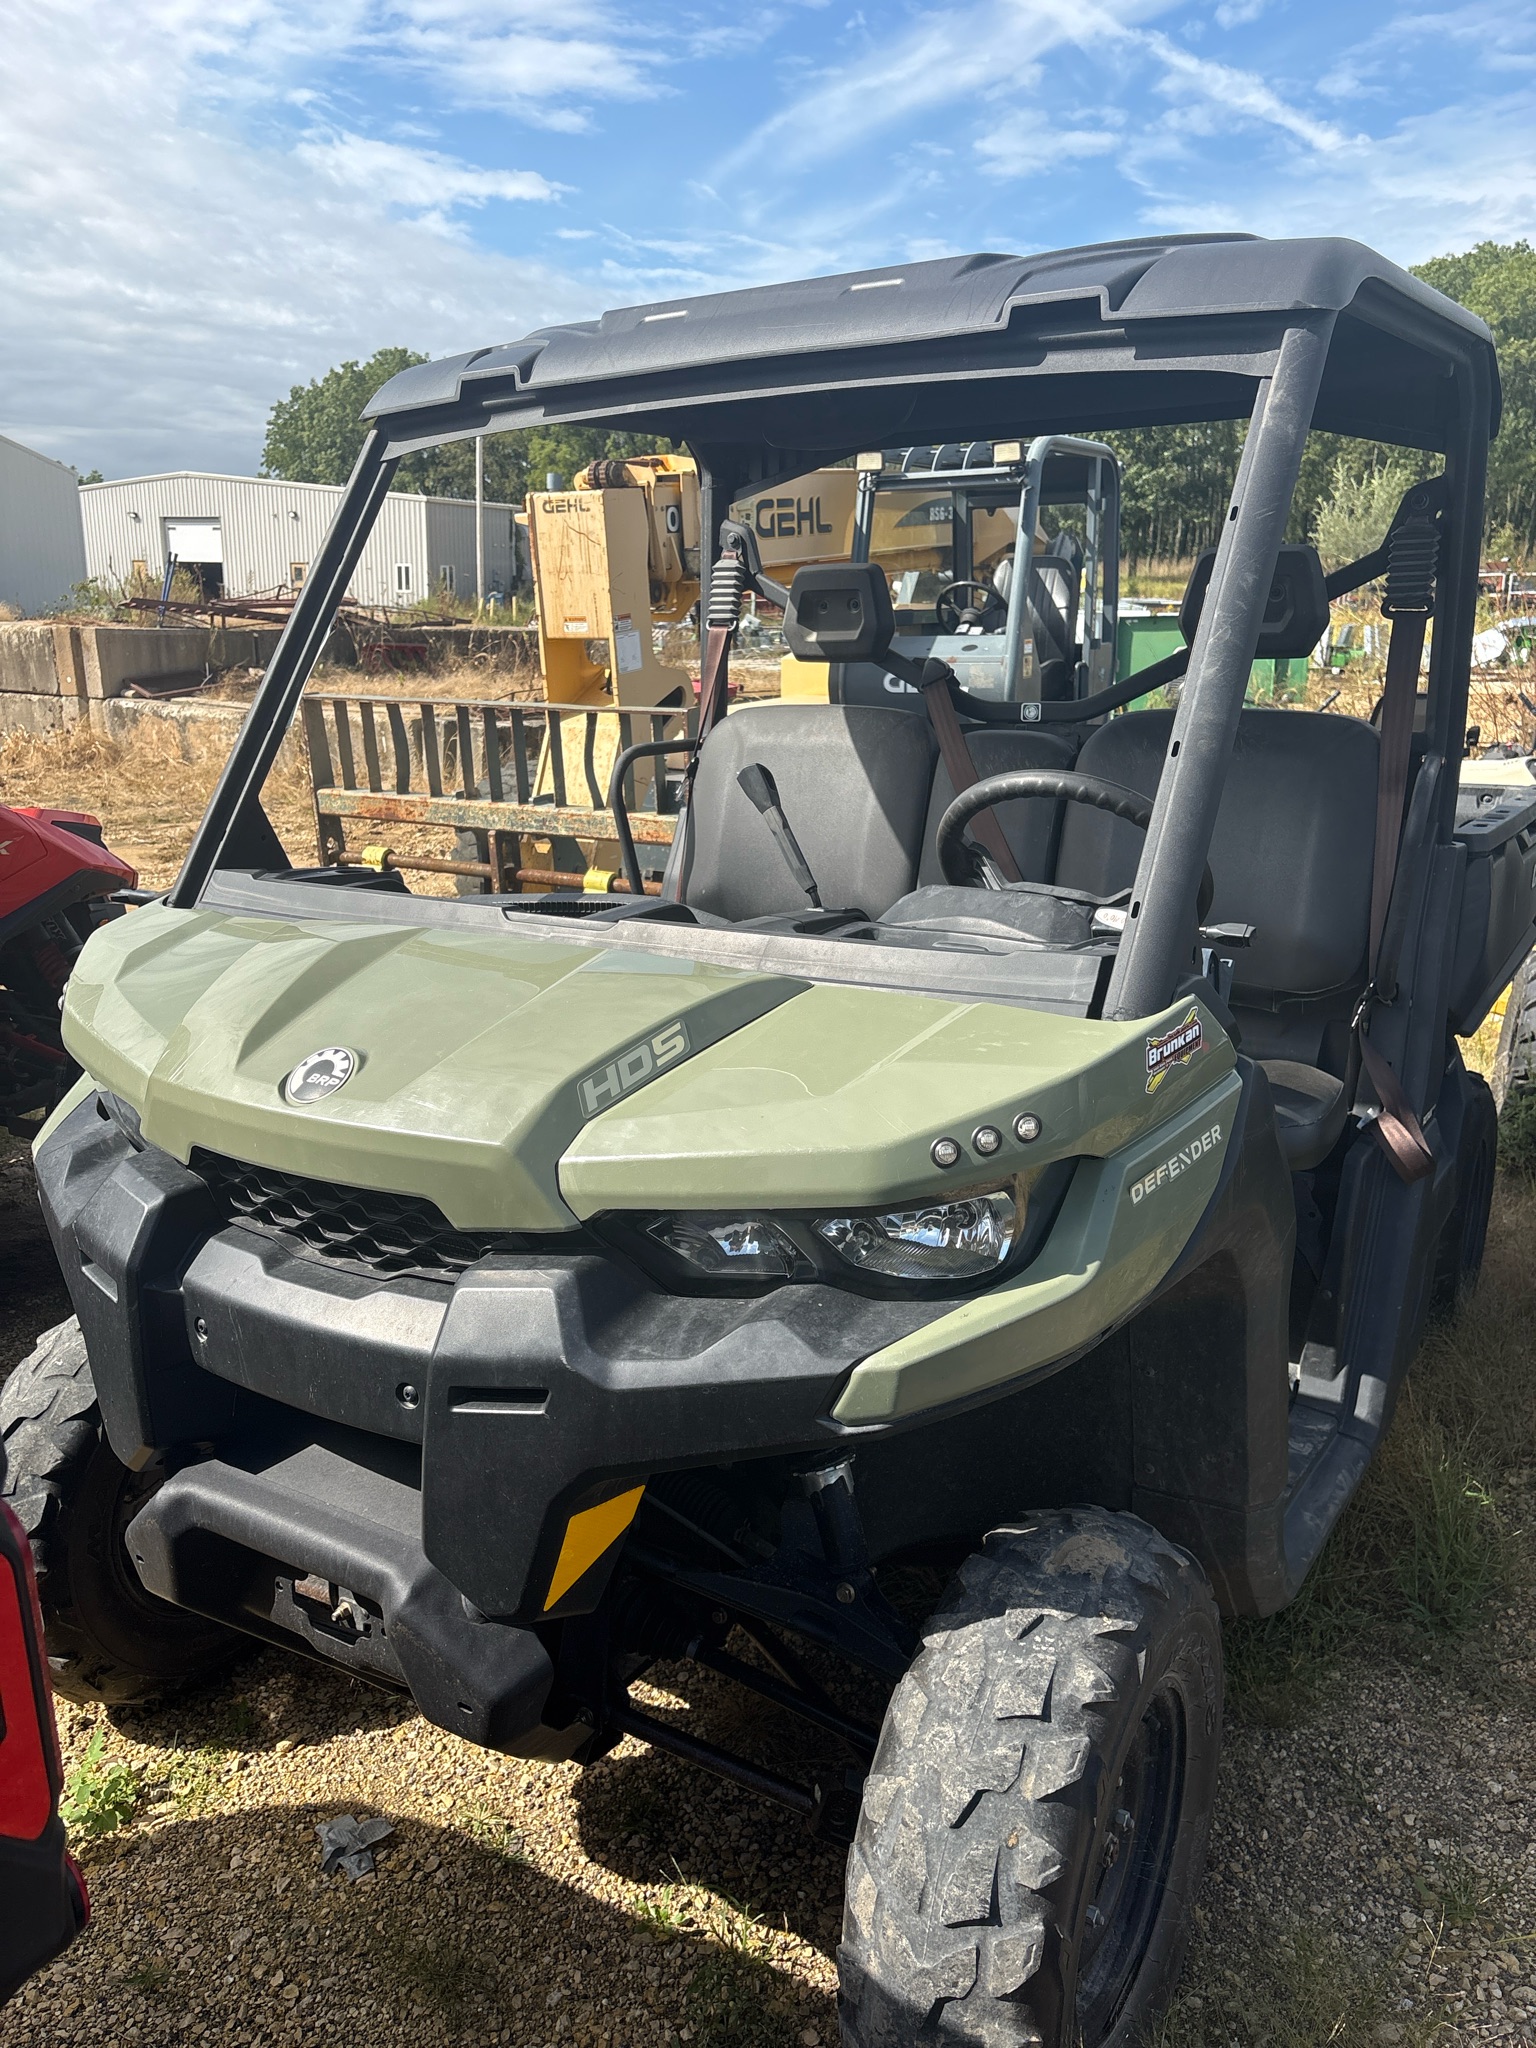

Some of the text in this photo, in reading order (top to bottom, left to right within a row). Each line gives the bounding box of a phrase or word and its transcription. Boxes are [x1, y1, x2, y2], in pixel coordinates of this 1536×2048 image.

[543, 498, 591, 514] GEHL
[756, 496, 832, 538] GEHL
[1148, 1024, 1200, 1067] Brunkan
[306, 1073, 340, 1087] BRP
[582, 1022, 685, 1113] HDS
[1131, 1124, 1222, 1205] DEFENDER
